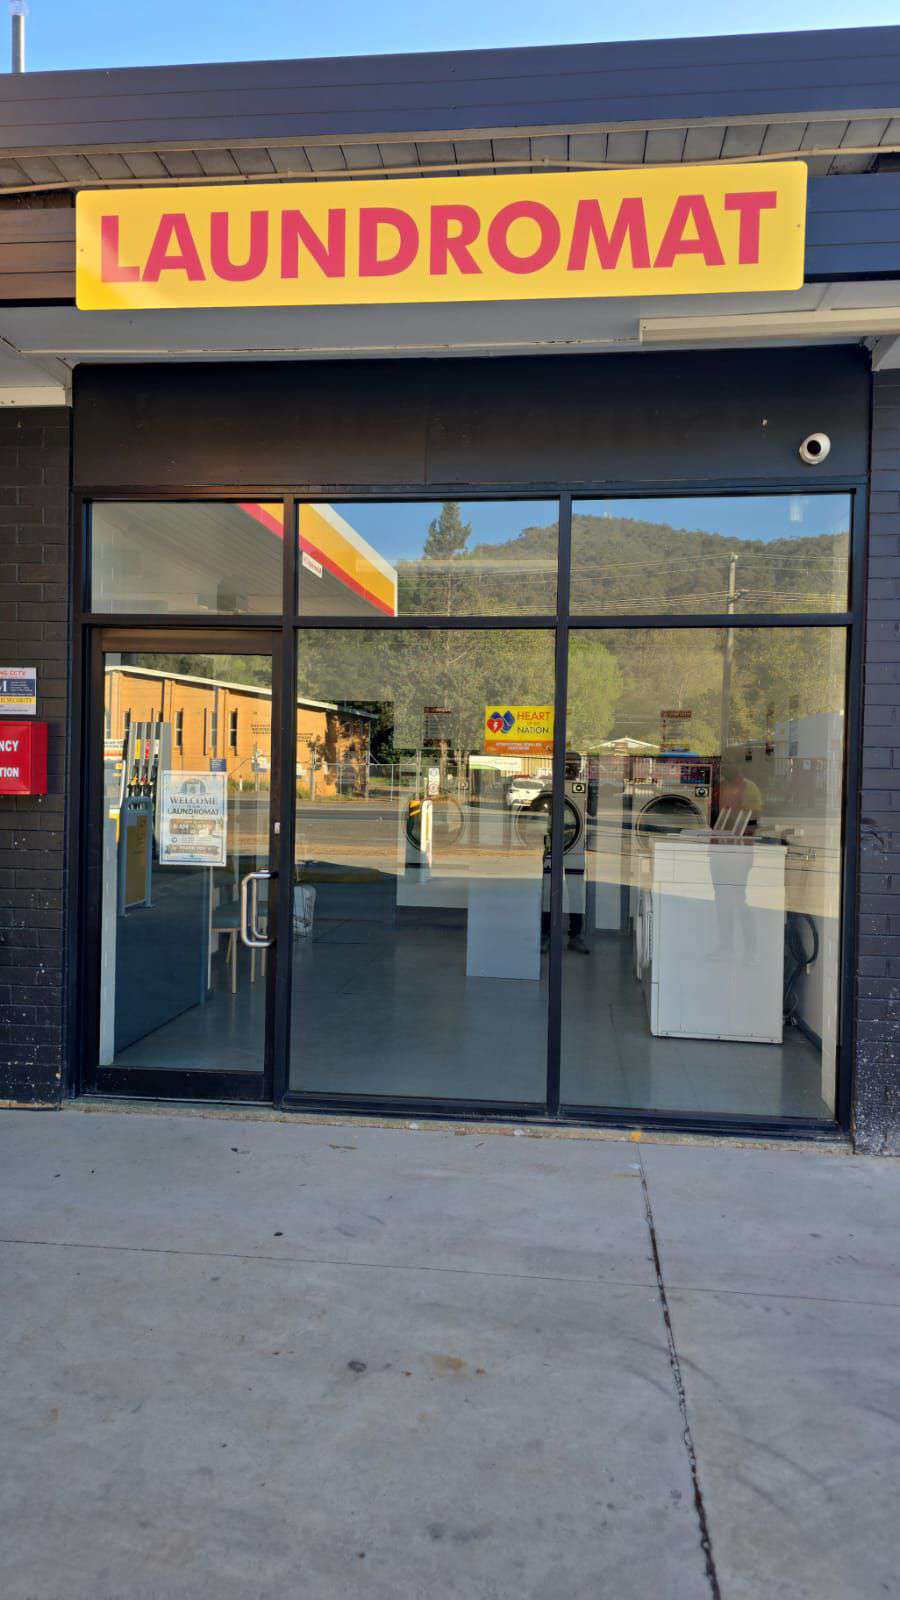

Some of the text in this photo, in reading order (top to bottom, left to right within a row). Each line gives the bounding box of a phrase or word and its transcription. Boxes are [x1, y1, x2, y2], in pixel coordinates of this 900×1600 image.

[100, 190, 777, 284] LAUNDROMAT
[517, 711, 551, 721] HEART
[517, 726, 549, 734] NATION
[170, 796, 217, 805] WELCOME
[168, 807, 219, 815] LAUNDROMAT
